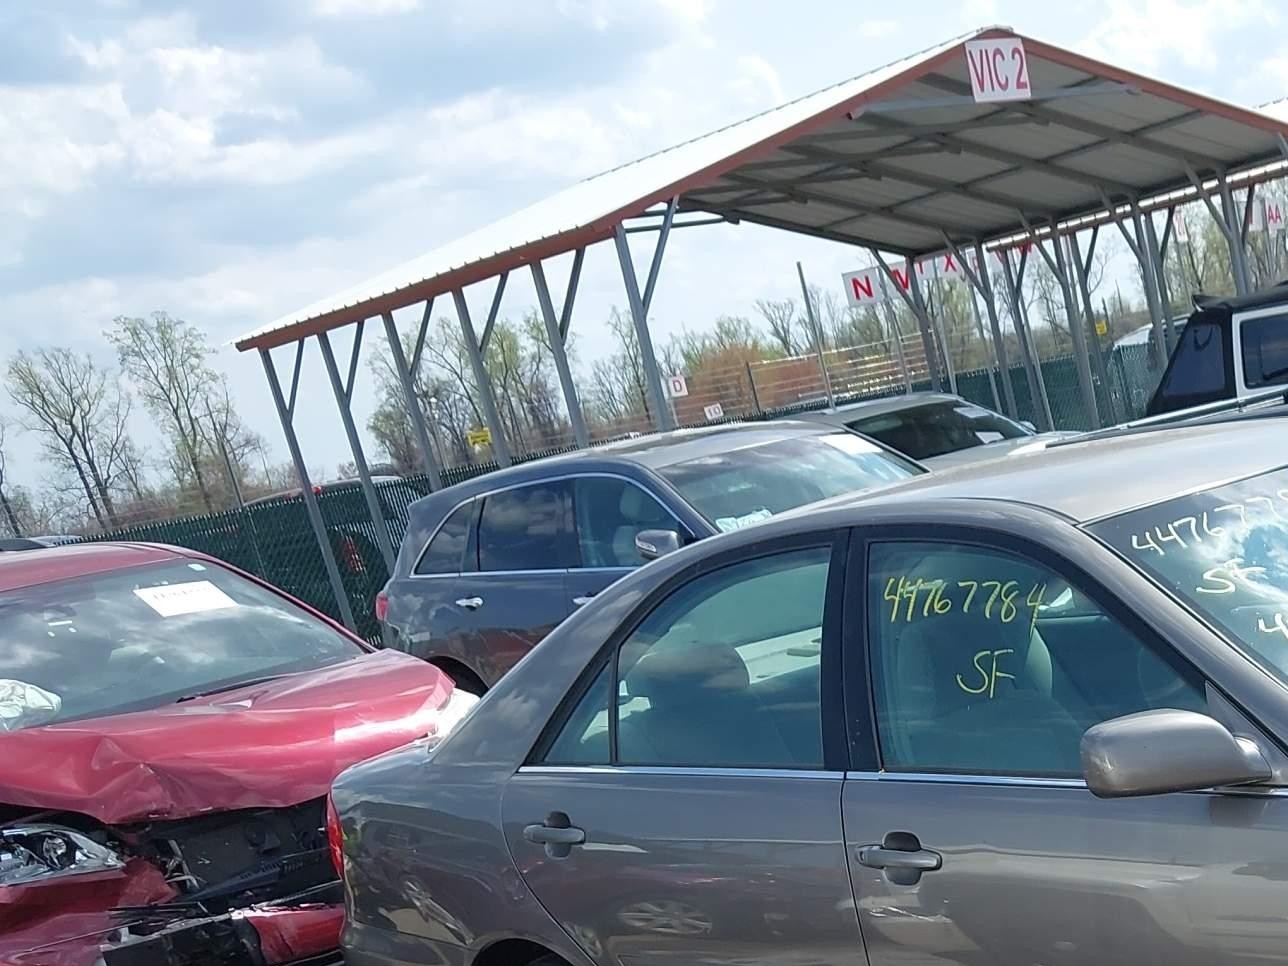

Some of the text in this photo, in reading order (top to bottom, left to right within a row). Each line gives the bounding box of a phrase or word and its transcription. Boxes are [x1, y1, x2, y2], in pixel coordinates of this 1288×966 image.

[968, 47, 1028, 93] VIC 2
[1267, 203, 1283, 225] AA
[944, 252, 957, 273] X
[851, 275, 874, 300] N
[672, 379, 683, 393] D
[884, 575, 1047, 640] 44767784
[955, 648, 1017, 699] SF
